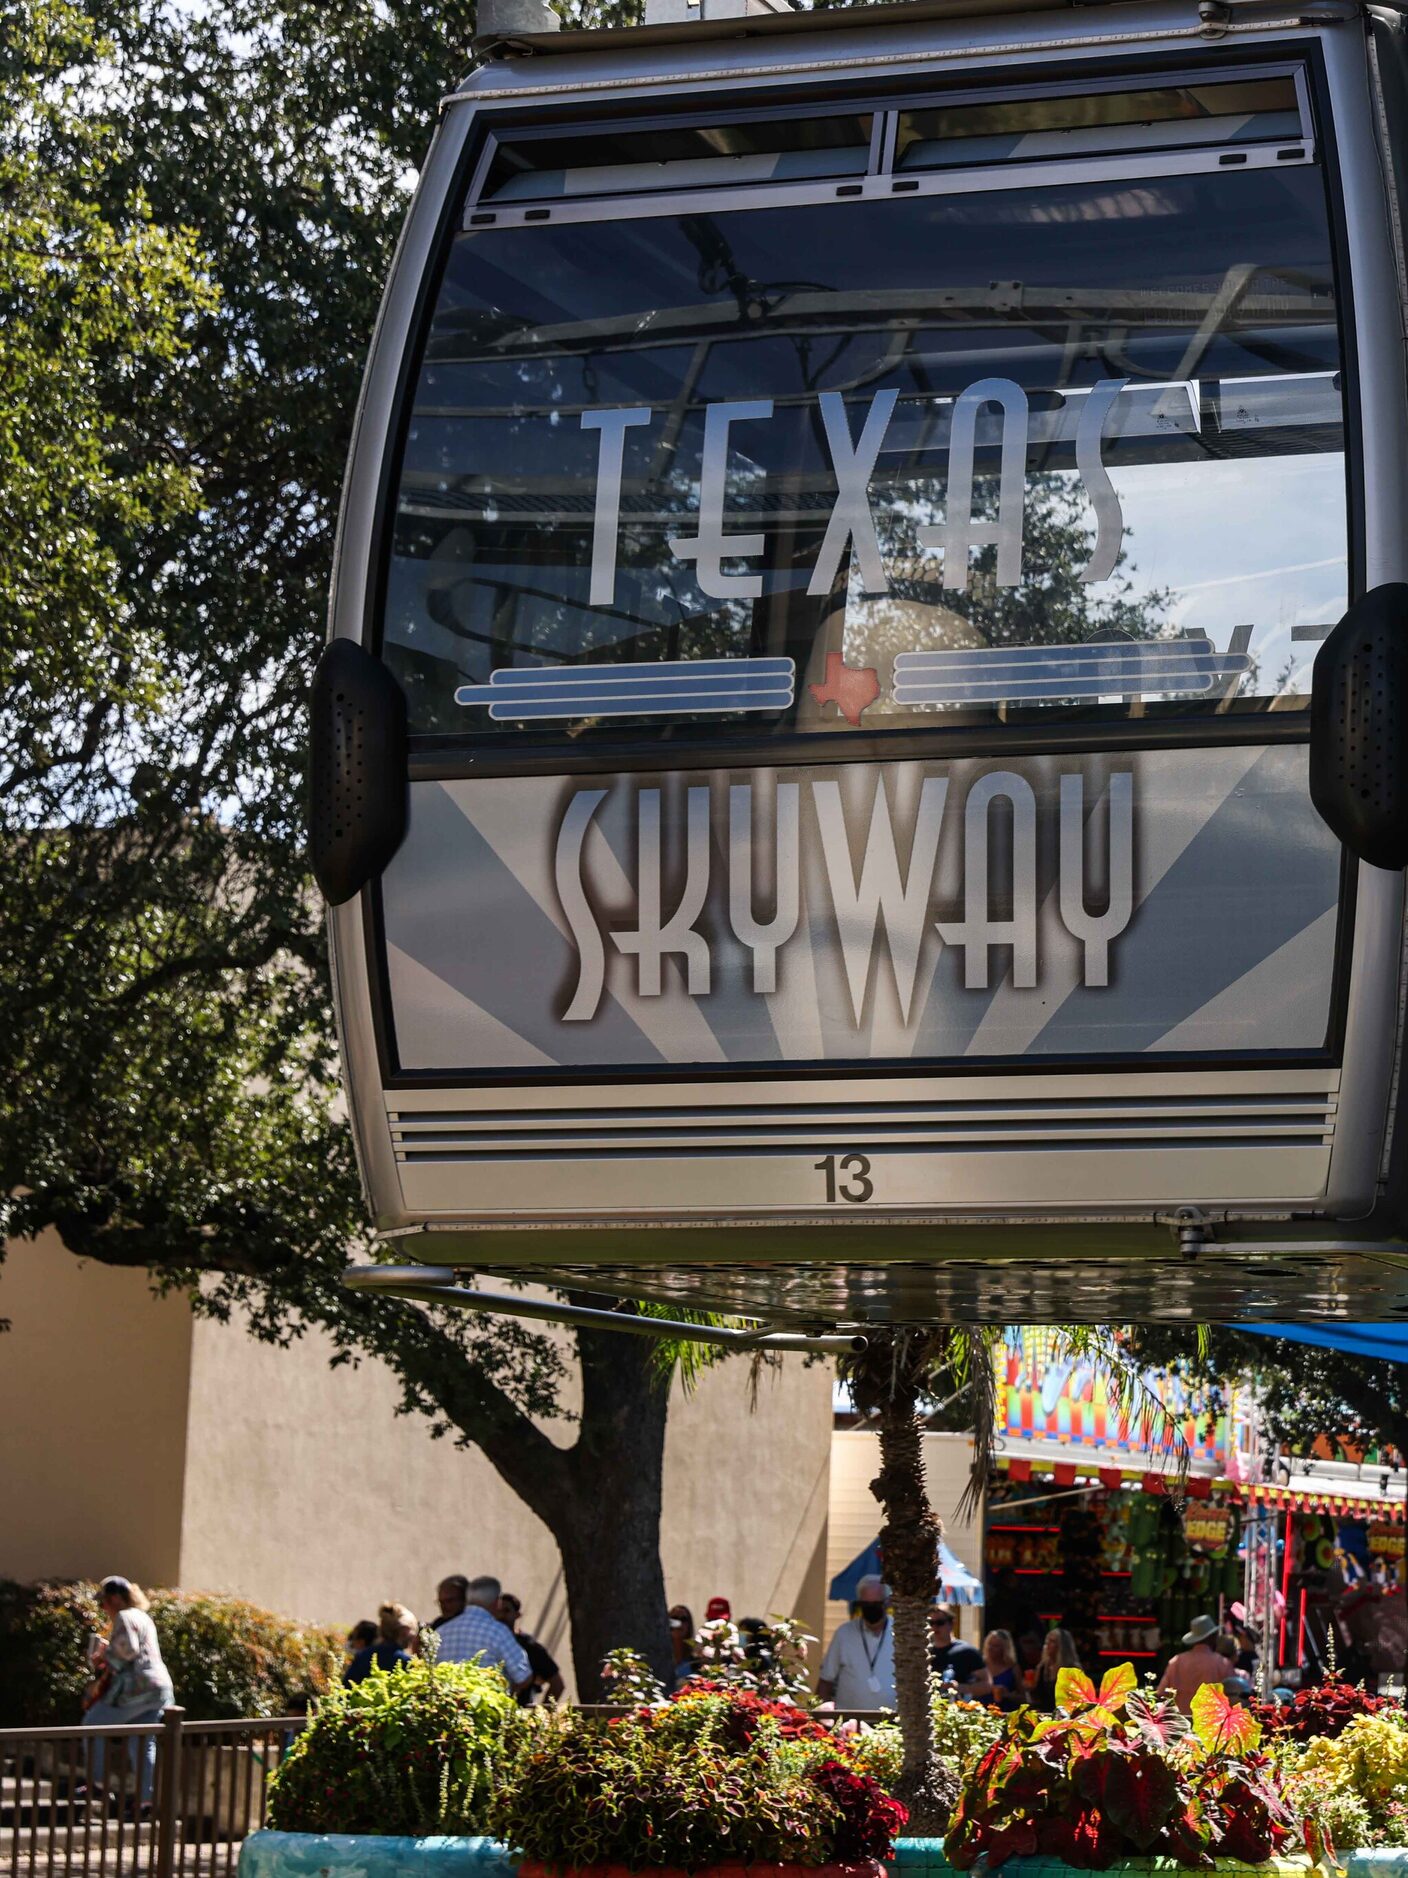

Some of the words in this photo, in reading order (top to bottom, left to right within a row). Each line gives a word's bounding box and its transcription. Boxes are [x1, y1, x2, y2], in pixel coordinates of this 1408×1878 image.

[581, 378, 1130, 605] TEXAS
[557, 769, 1133, 1029] SKYWAY
[814, 1153, 872, 1203] 13
